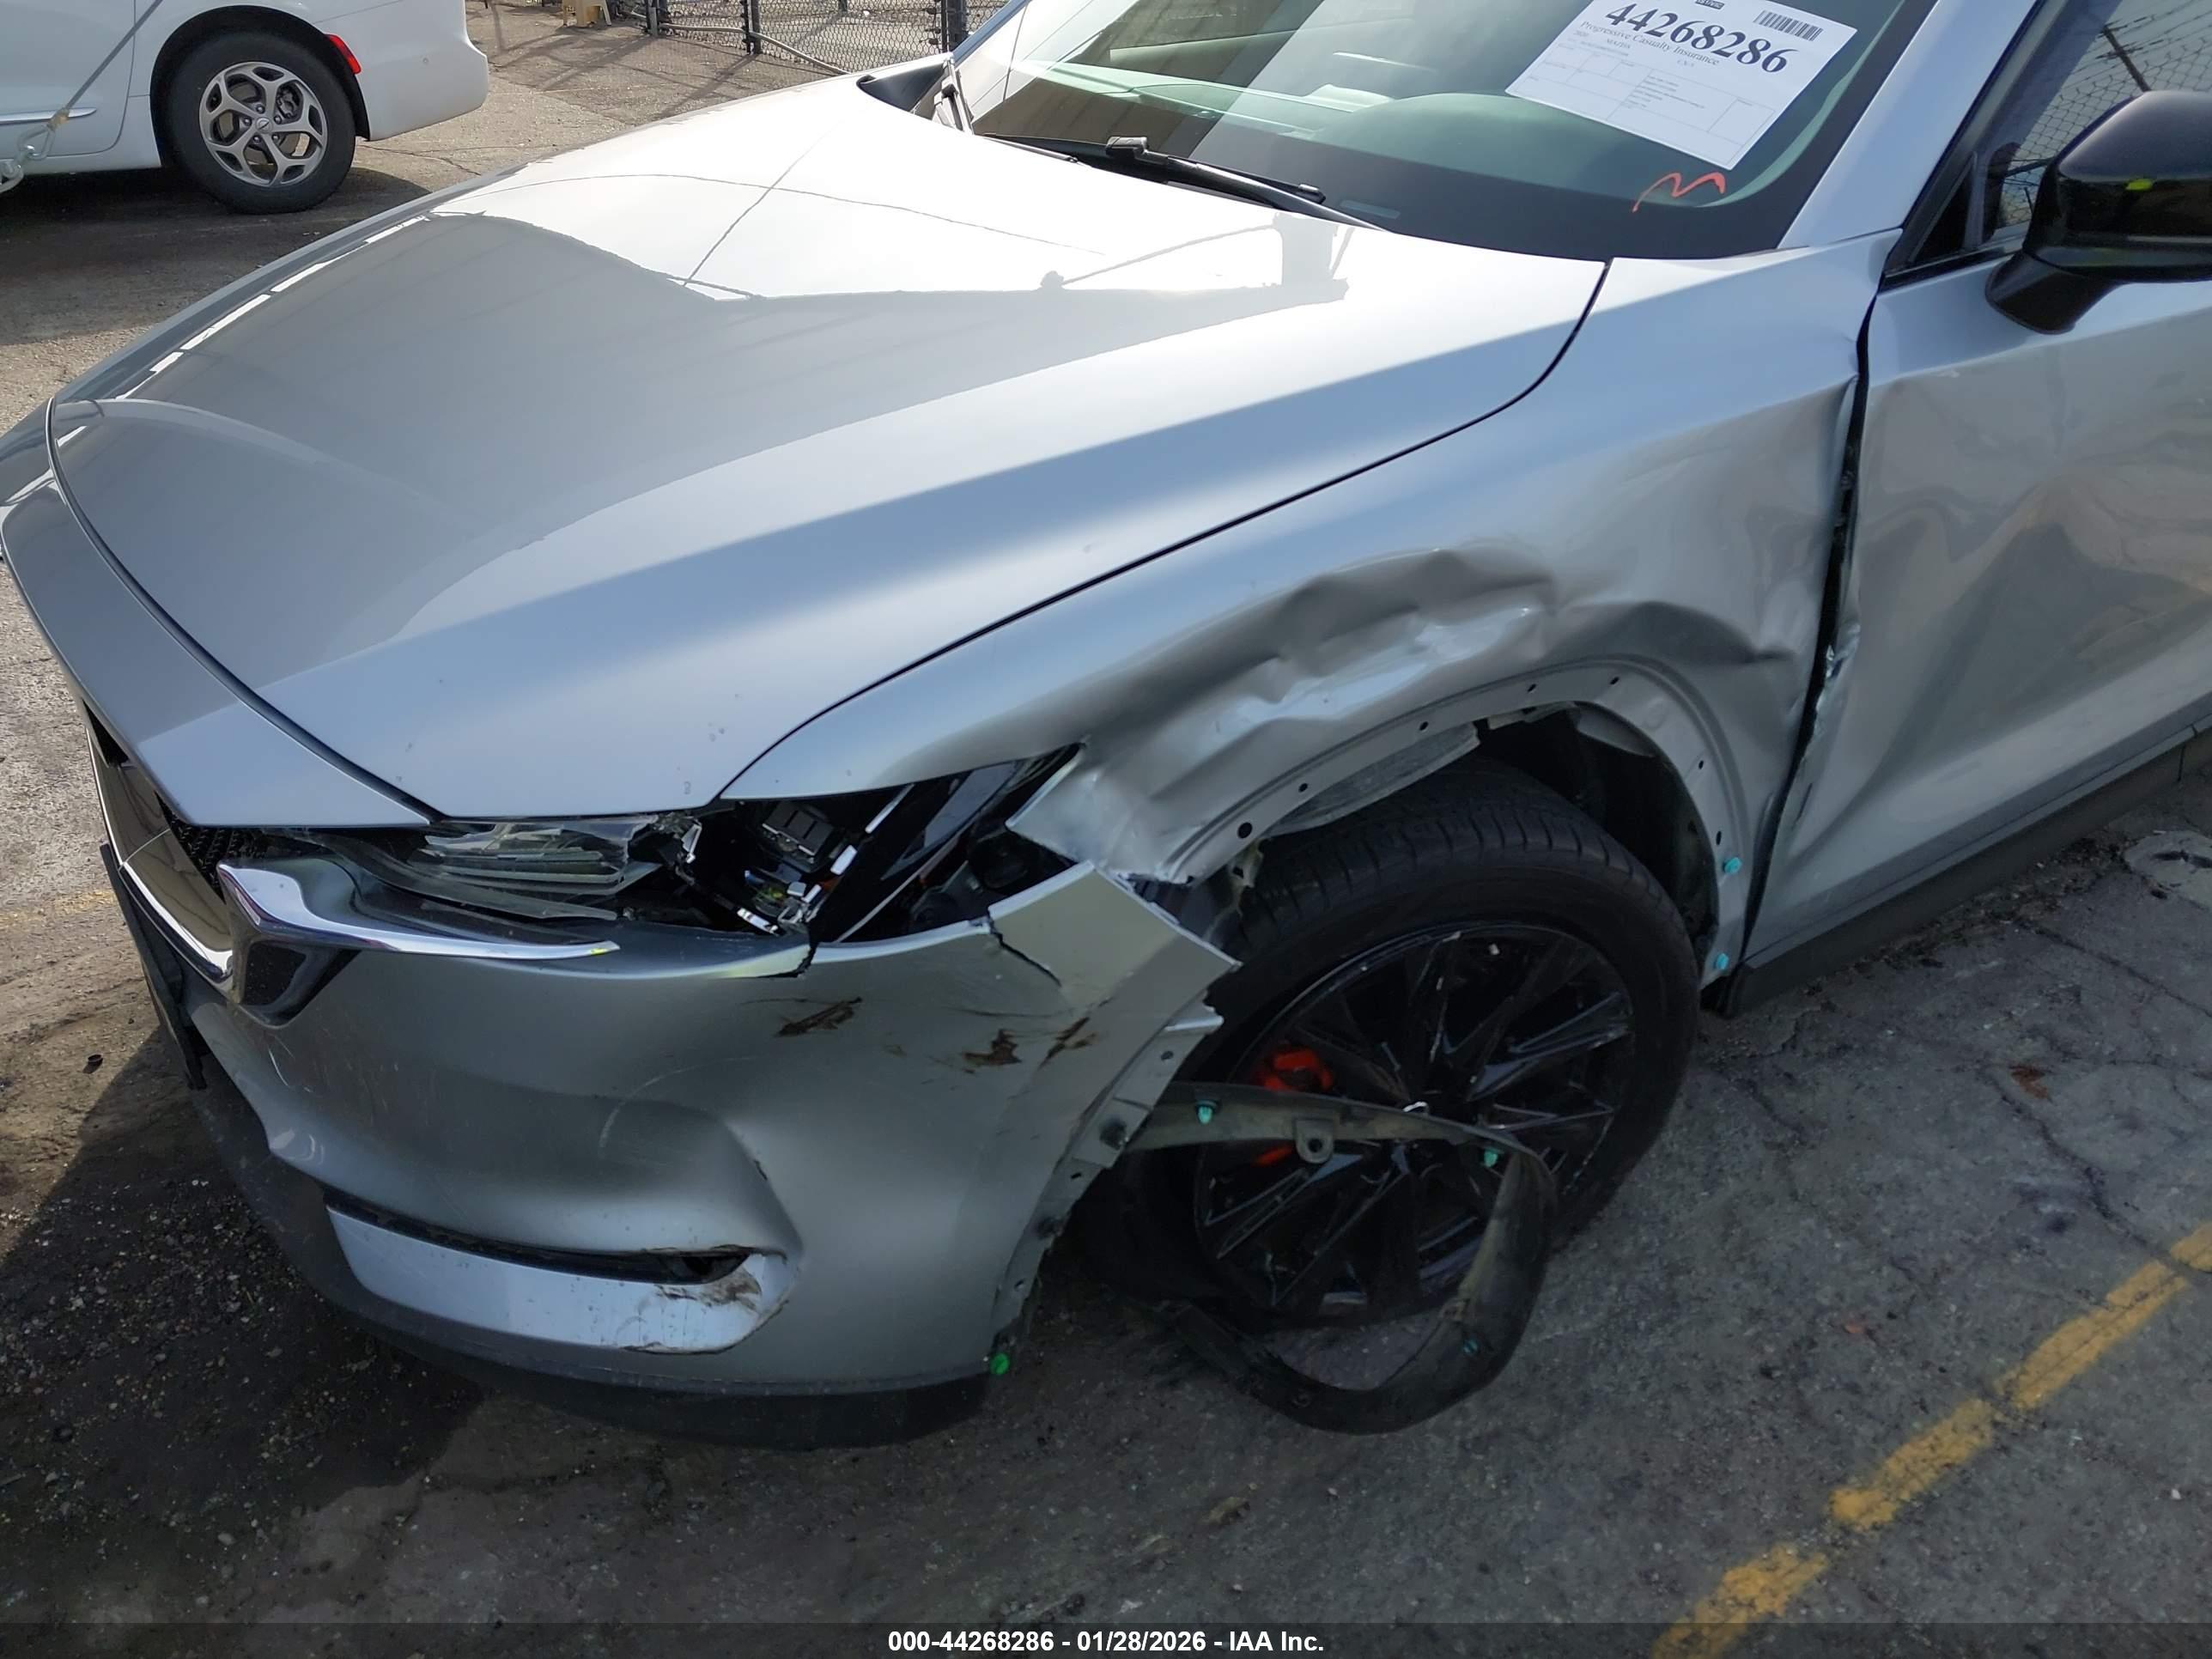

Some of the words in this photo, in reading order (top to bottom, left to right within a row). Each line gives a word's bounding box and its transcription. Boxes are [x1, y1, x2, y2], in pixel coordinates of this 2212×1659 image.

[1580, 21, 1632, 39] Progressive
[1632, 34, 1671, 52] Casualty
[1674, 46, 1719, 65] Insurance
[1605, 3, 1800, 73] 44268286
